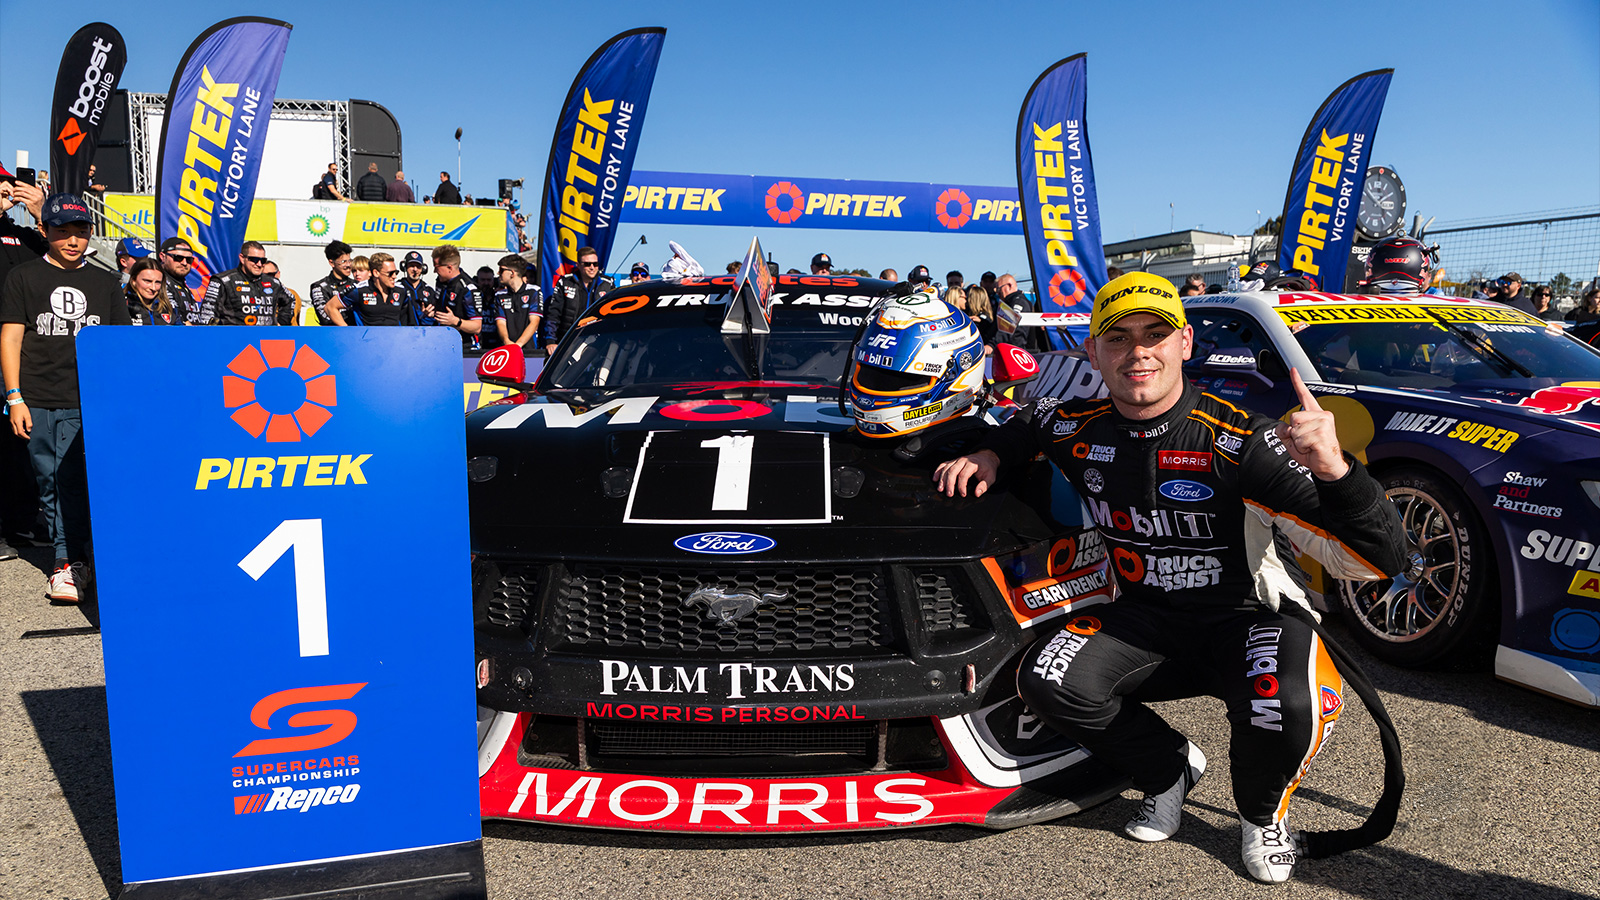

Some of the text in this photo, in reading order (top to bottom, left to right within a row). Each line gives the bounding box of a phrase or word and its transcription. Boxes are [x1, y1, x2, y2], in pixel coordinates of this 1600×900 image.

[68, 36, 112, 120] boost
[89, 72, 115, 126] mobile
[176, 64, 240, 259] PIRTEK
[219, 86, 262, 219] VICTORY LANE
[596, 100, 635, 229] VICTORY LANE
[557, 86, 615, 263] PIRTEK
[1067, 119, 1089, 231] VICTORY LANE
[622, 185, 727, 212] PIRTEK
[1033, 121, 1079, 268] PIRTEK
[1331, 132, 1365, 242] VICTORY LANE
[805, 193, 907, 218] PIRTEK
[1292, 127, 1350, 276] PIRTEK
[362, 217, 446, 235] ultimate
[1351, 246, 1372, 254] SEIK
[680, 274, 860, 287] cotes
[63, 291, 75, 314] B
[656, 293, 789, 308] TRUK
[792, 292, 880, 308] ASSI
[1099, 285, 1174, 313] DUNLOP
[920, 320, 948, 333] Mobil
[1279, 307, 1424, 323] NATIONAL
[858, 350, 882, 362] Mobil
[1207, 354, 1256, 363] ACDelco
[1306, 385, 1355, 395] DUNLOP
[904, 407, 928, 420] DAYLE
[1053, 422, 1077, 434] OMP
[1129, 428, 1158, 439] Mobil
[1384, 411, 1520, 453] MAKE IT SUPER
[1091, 444, 1116, 455] TRUCK
[1217, 434, 1243, 452] OMP
[1086, 452, 1115, 463] ASSIST
[1162, 456, 1208, 467] MORRIS
[195, 454, 374, 490] PIRTEK
[700, 435, 755, 511] 1
[1503, 471, 1548, 487] Shaw
[1170, 484, 1201, 498] Ford
[1499, 485, 1531, 498] and
[1088, 497, 1172, 538] Mobil
[1184, 515, 1200, 537] 1
[1493, 494, 1563, 518] Partners
[694, 534, 755, 553] Ford
[1078, 530, 1102, 551] TRU
[1144, 554, 1222, 575] TRUCK
[237, 518, 330, 657] 1
[1143, 567, 1223, 593] ASSIST
[1447, 527, 1471, 628] DUNLOP
[1023, 570, 1109, 610] GEARWRENCH
[1033, 629, 1068, 680] ASSIST
[1049, 633, 1089, 687] TRUCK
[600, 659, 856, 699] PALM TRANS
[1246, 645, 1282, 732] Mobil
[587, 702, 866, 724] MORRIS PERSONAL
[231, 755, 360, 777] SUPERCARS
[232, 767, 361, 788] CHAMPIONSHIP
[265, 784, 362, 813] Repco
[508, 772, 935, 825] MORRIS
